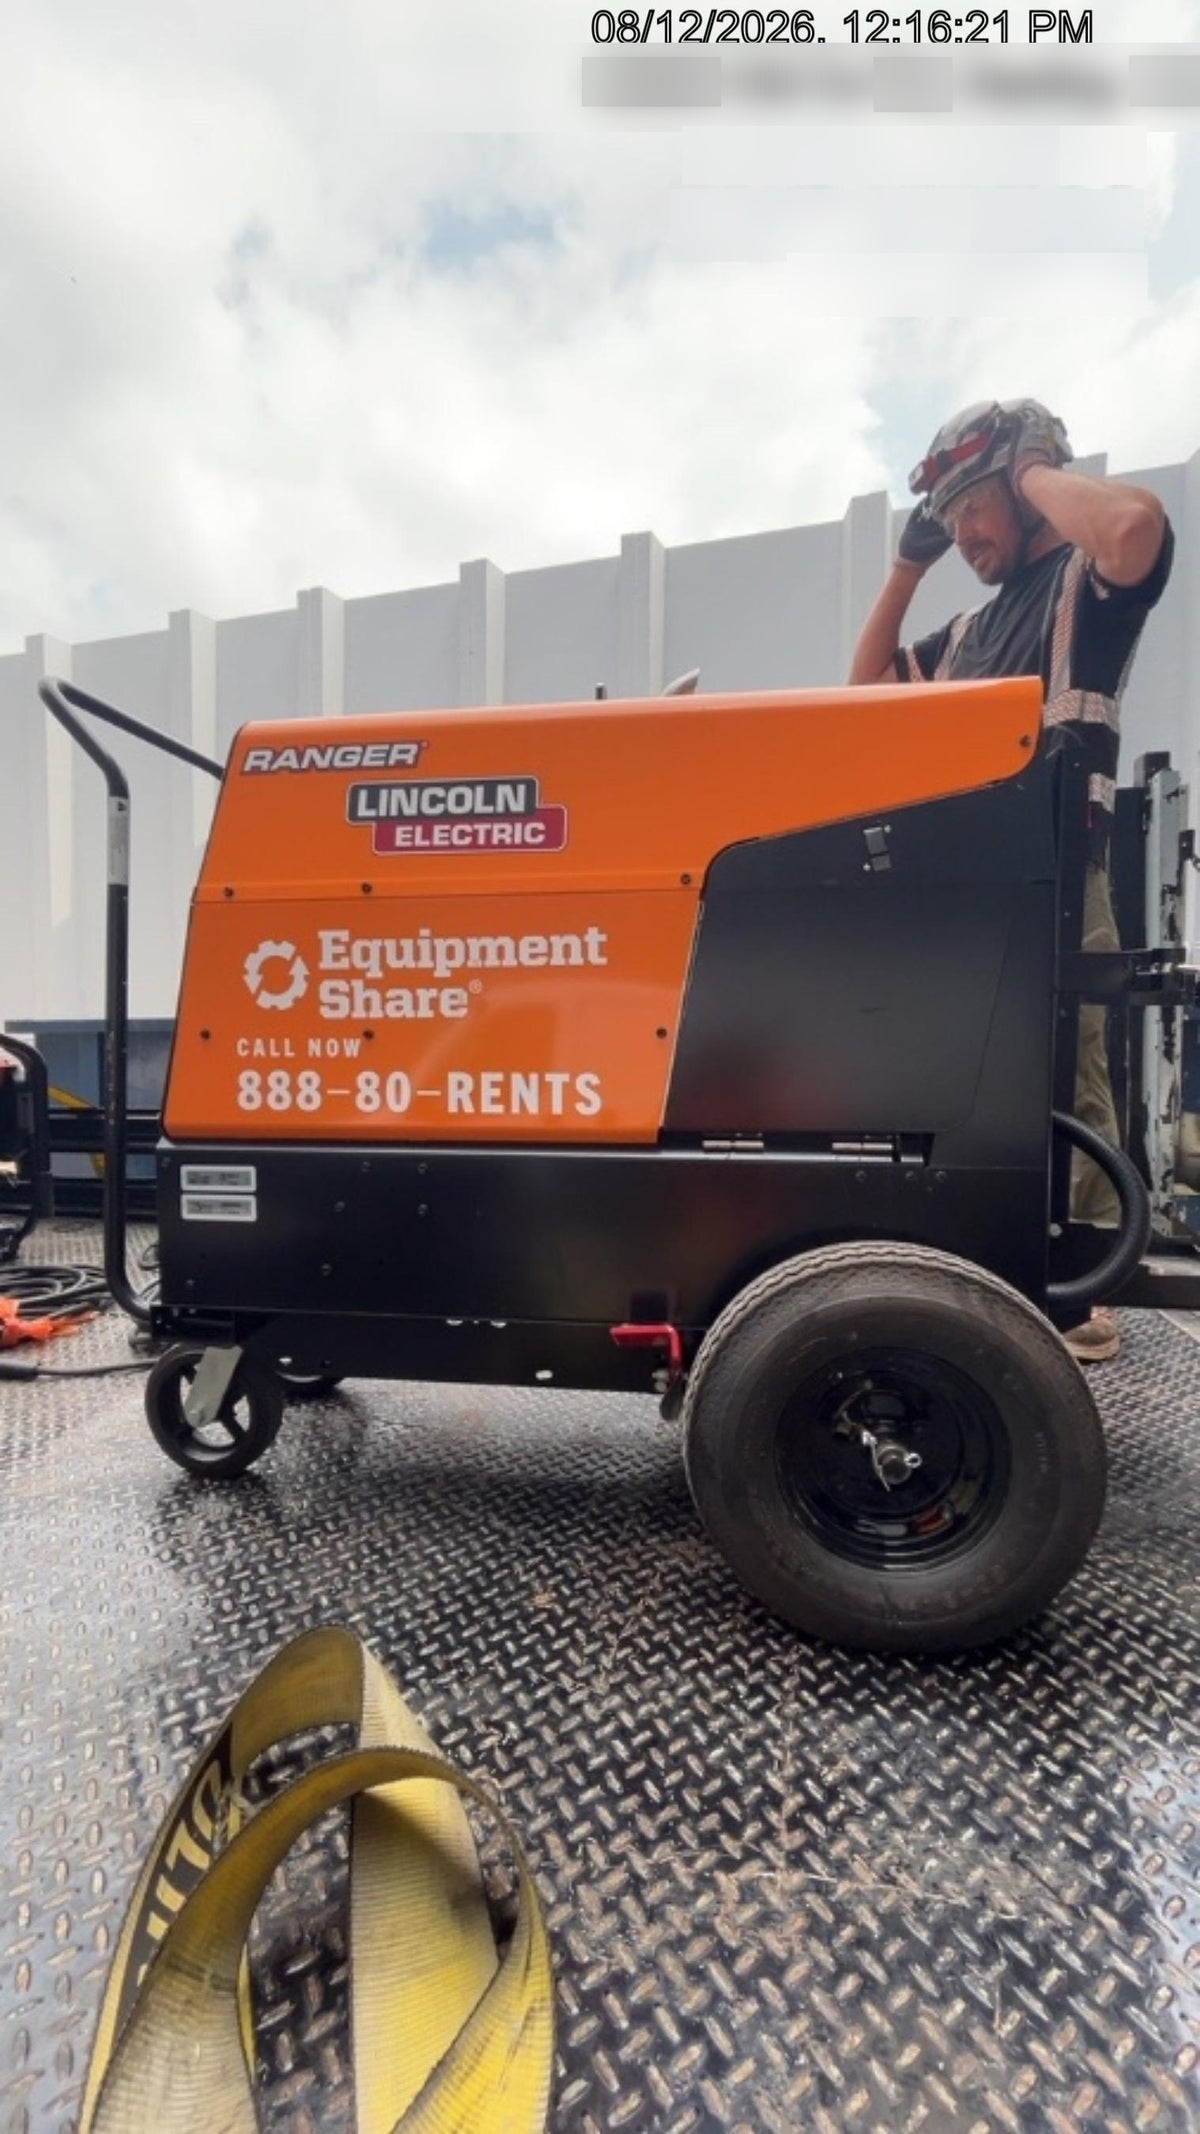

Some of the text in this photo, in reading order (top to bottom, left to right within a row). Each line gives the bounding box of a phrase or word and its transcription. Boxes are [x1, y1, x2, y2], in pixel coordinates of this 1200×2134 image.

[357, 784, 526, 818] LINCOLN
[394, 822, 546, 848] ELECTRIC
[317, 926, 608, 977] Equipment
[236, 1037, 362, 1058] CALL NOW
[237, 1069, 602, 1116] 888-80-RENTS
